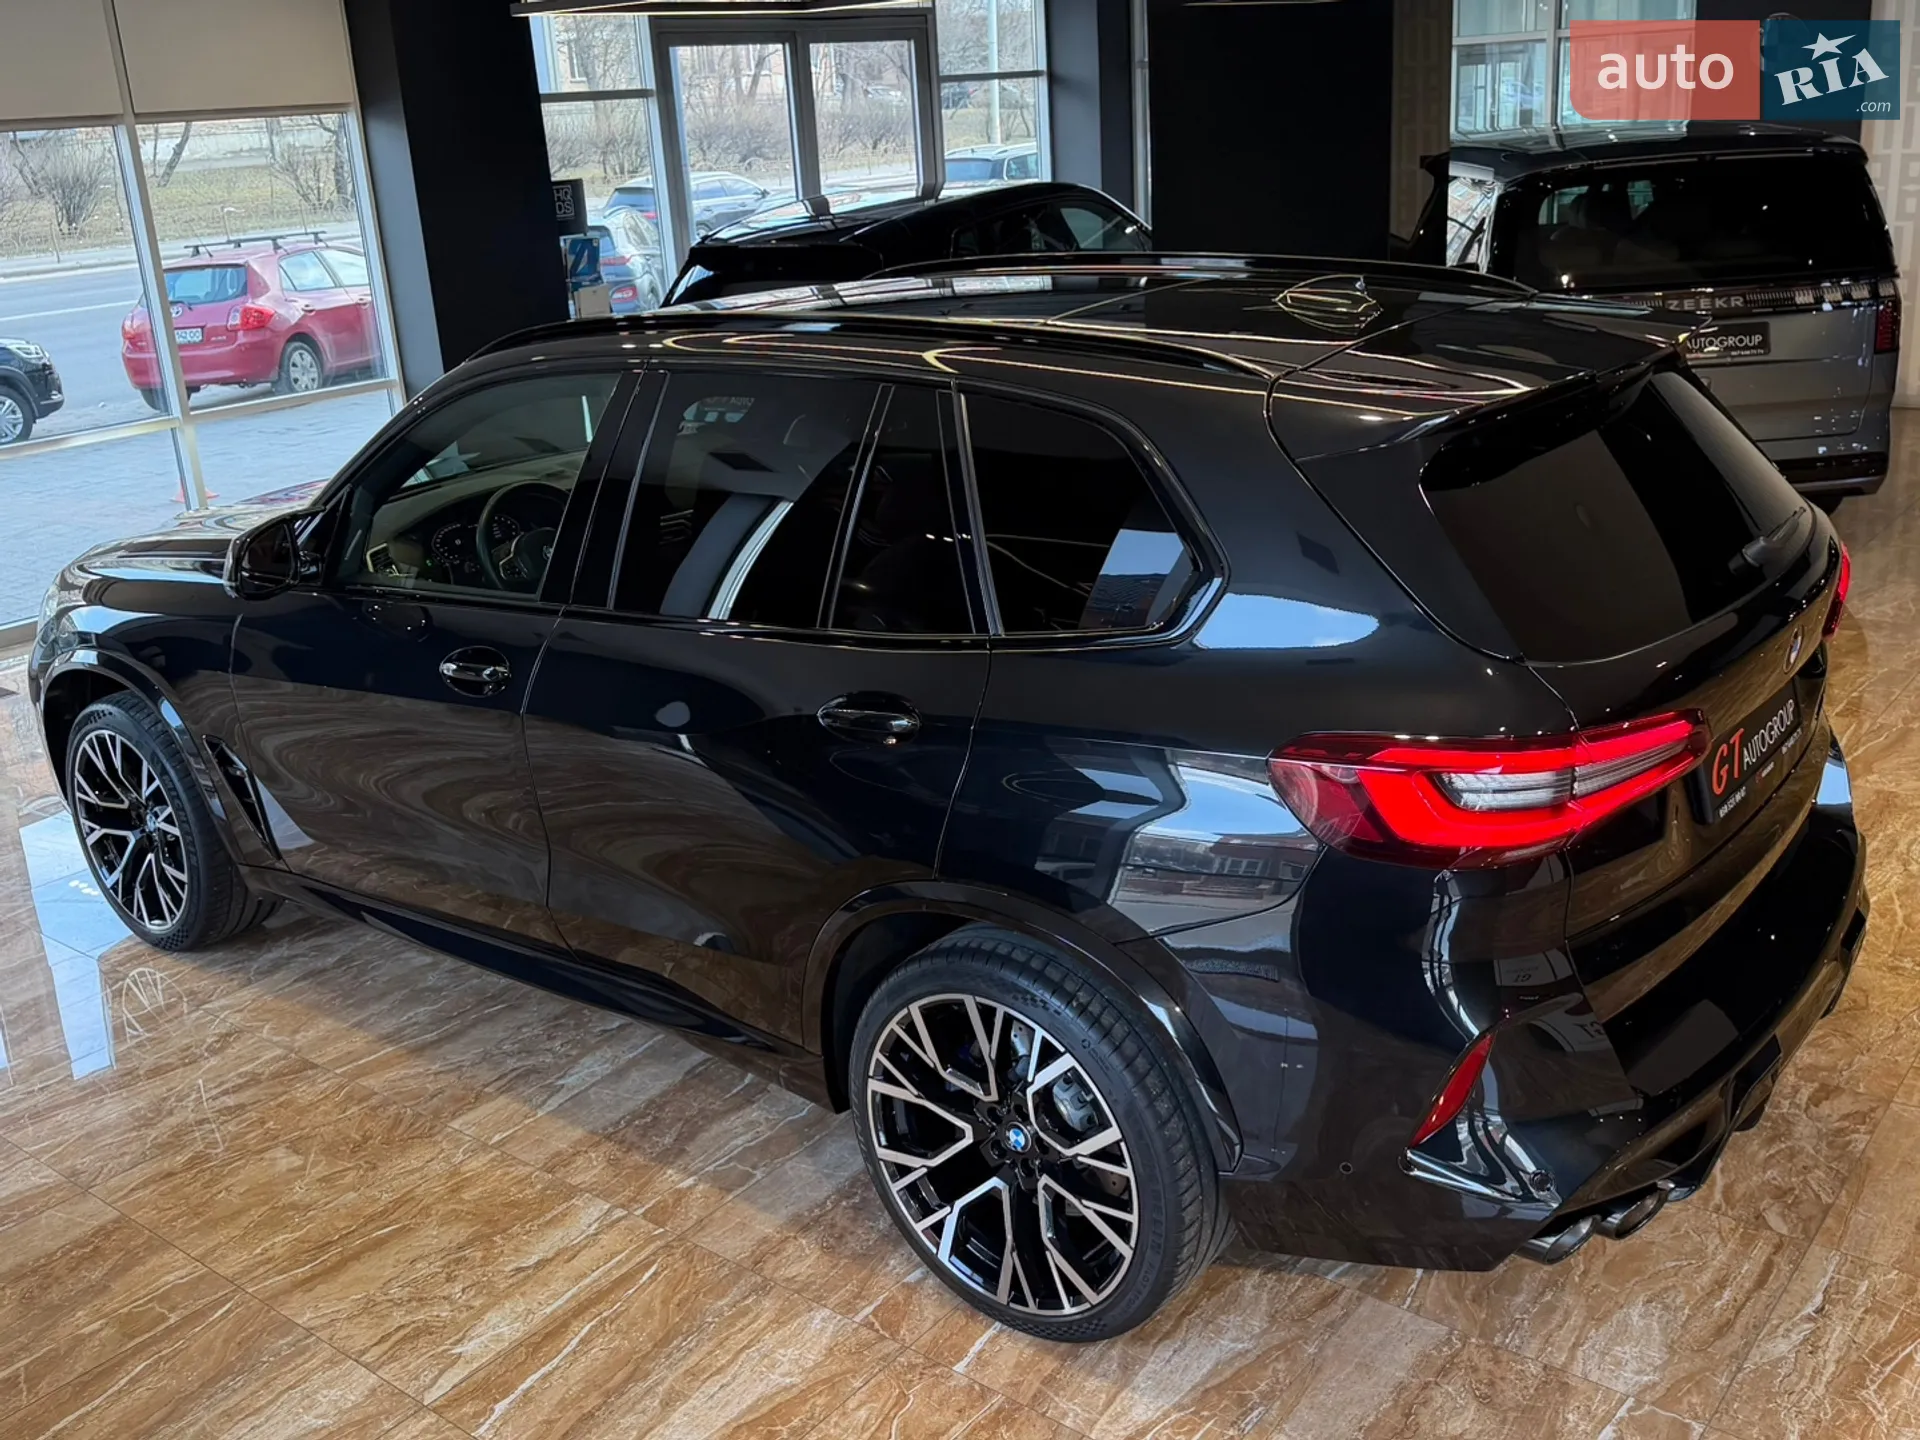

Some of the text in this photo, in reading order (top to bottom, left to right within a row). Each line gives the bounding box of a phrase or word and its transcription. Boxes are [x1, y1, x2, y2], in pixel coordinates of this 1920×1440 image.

[1666, 296, 1744, 311] ZEEKR
[1712, 728, 1744, 796] GT
[1743, 698, 1795, 771] AUTOGROUP
